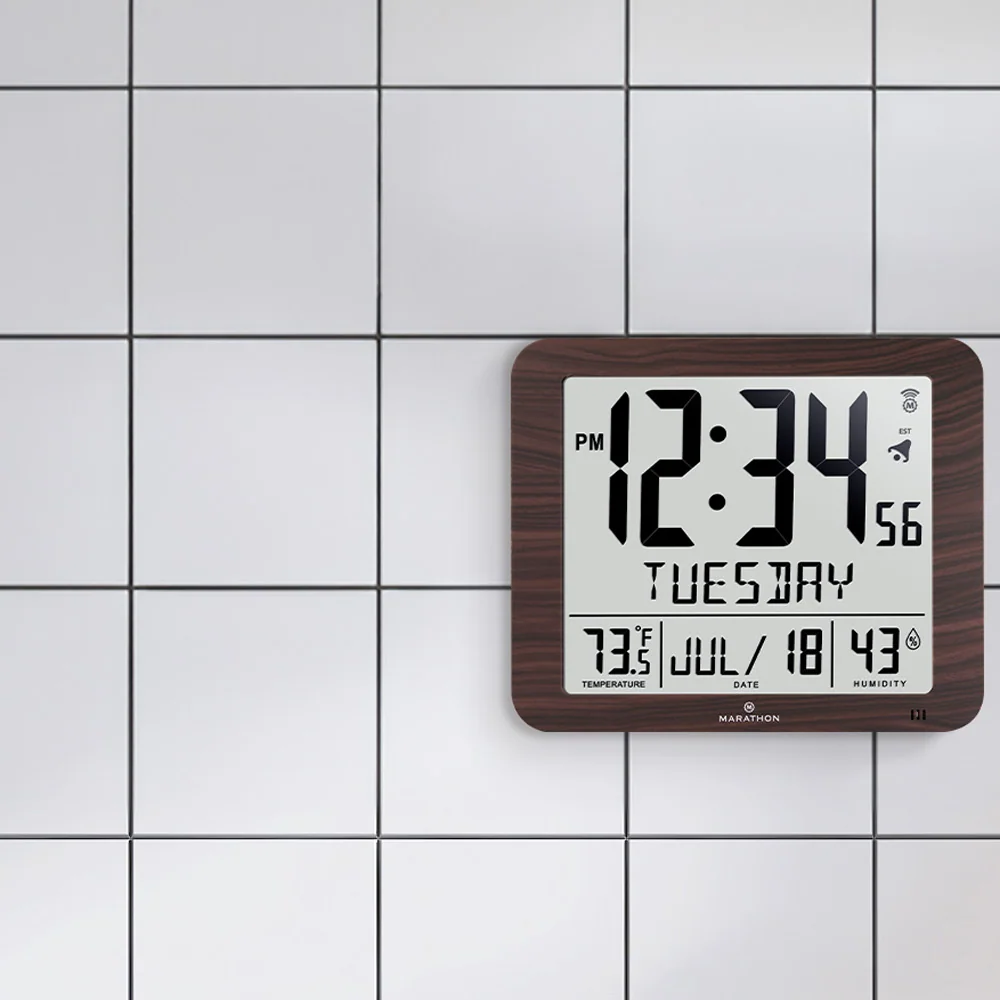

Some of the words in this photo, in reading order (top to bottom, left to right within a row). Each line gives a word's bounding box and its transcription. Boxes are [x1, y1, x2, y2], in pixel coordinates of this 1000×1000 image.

[575, 433, 604, 450] PM
[608, 389, 868, 547] 12:34
[876, 502, 922, 546] 56
[643, 562, 854, 604] TUESDAY
[787, 628, 823, 675] 18
[851, 627, 900, 675] 43
[853, 680, 907, 688] HUMIDITY
[719, 714, 780, 722] MARATHON
